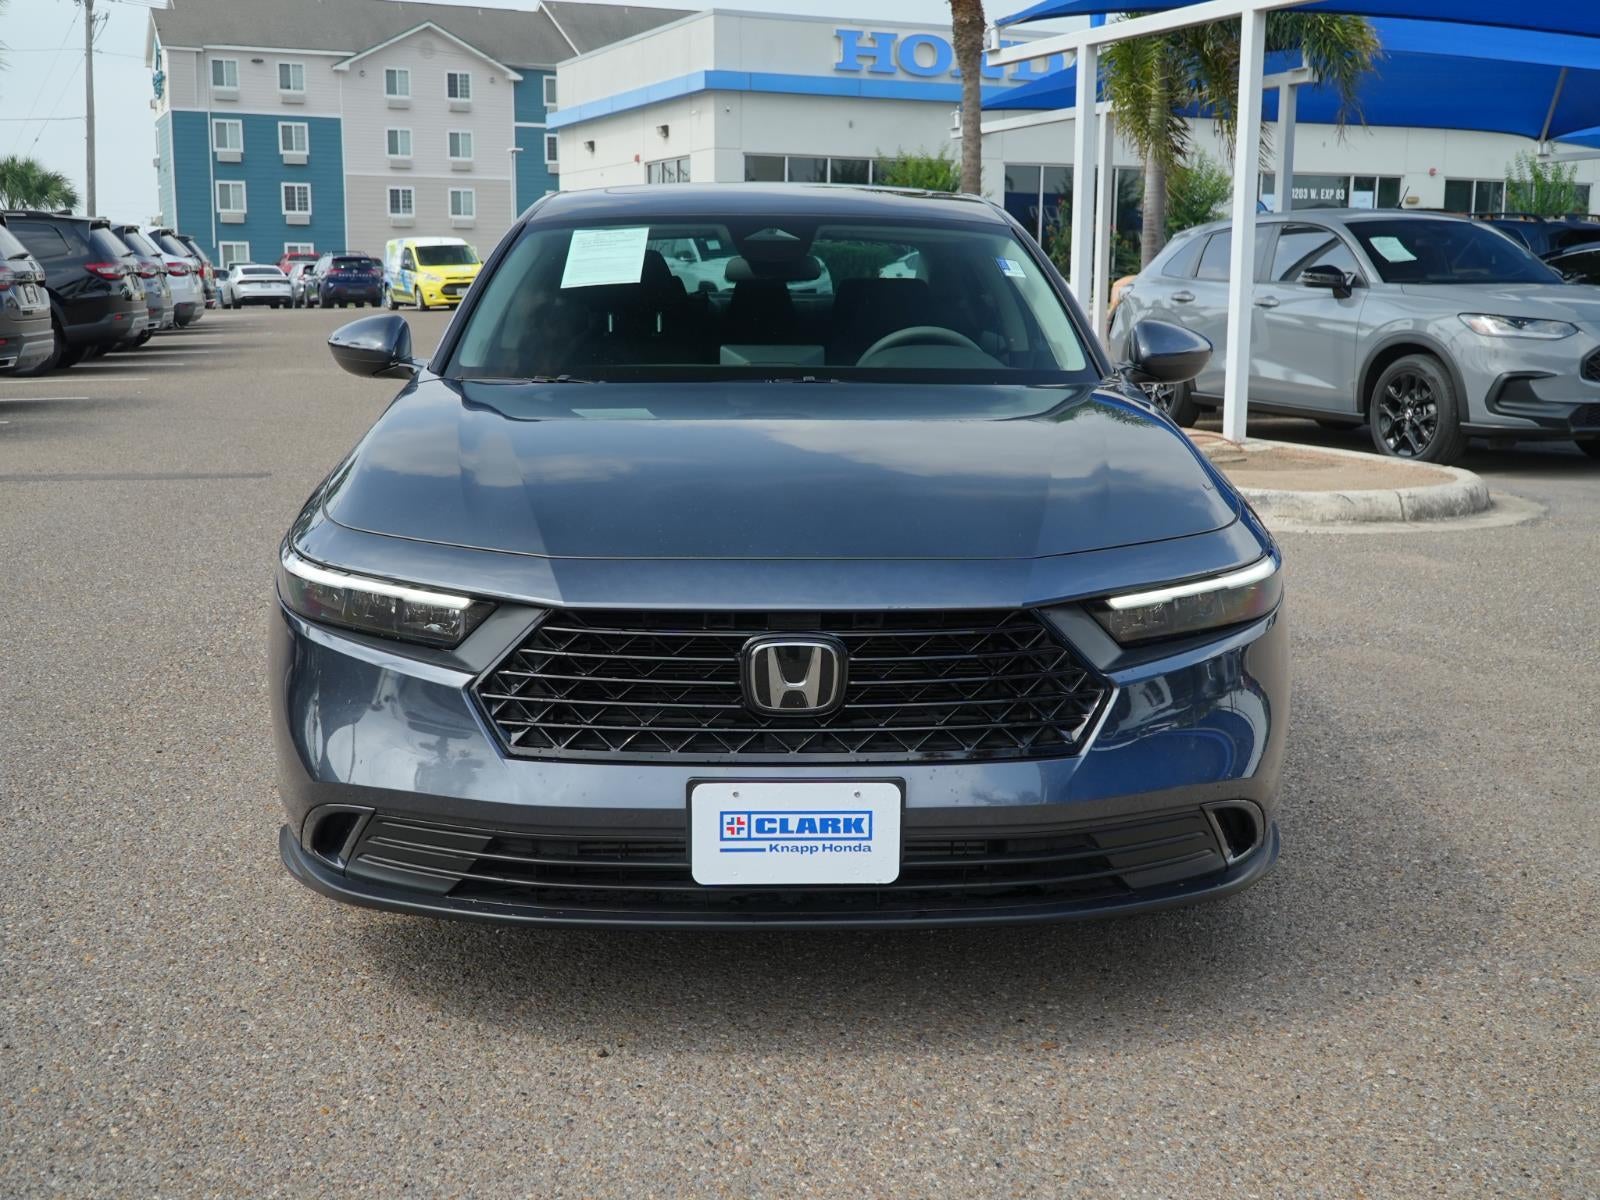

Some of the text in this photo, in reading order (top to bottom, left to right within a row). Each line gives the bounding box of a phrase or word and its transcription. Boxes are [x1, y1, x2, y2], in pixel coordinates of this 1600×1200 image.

[1320, 188, 1334, 200] EXP
[755, 817, 865, 834] CLARK
[769, 843, 872, 855] Knapp Honda
